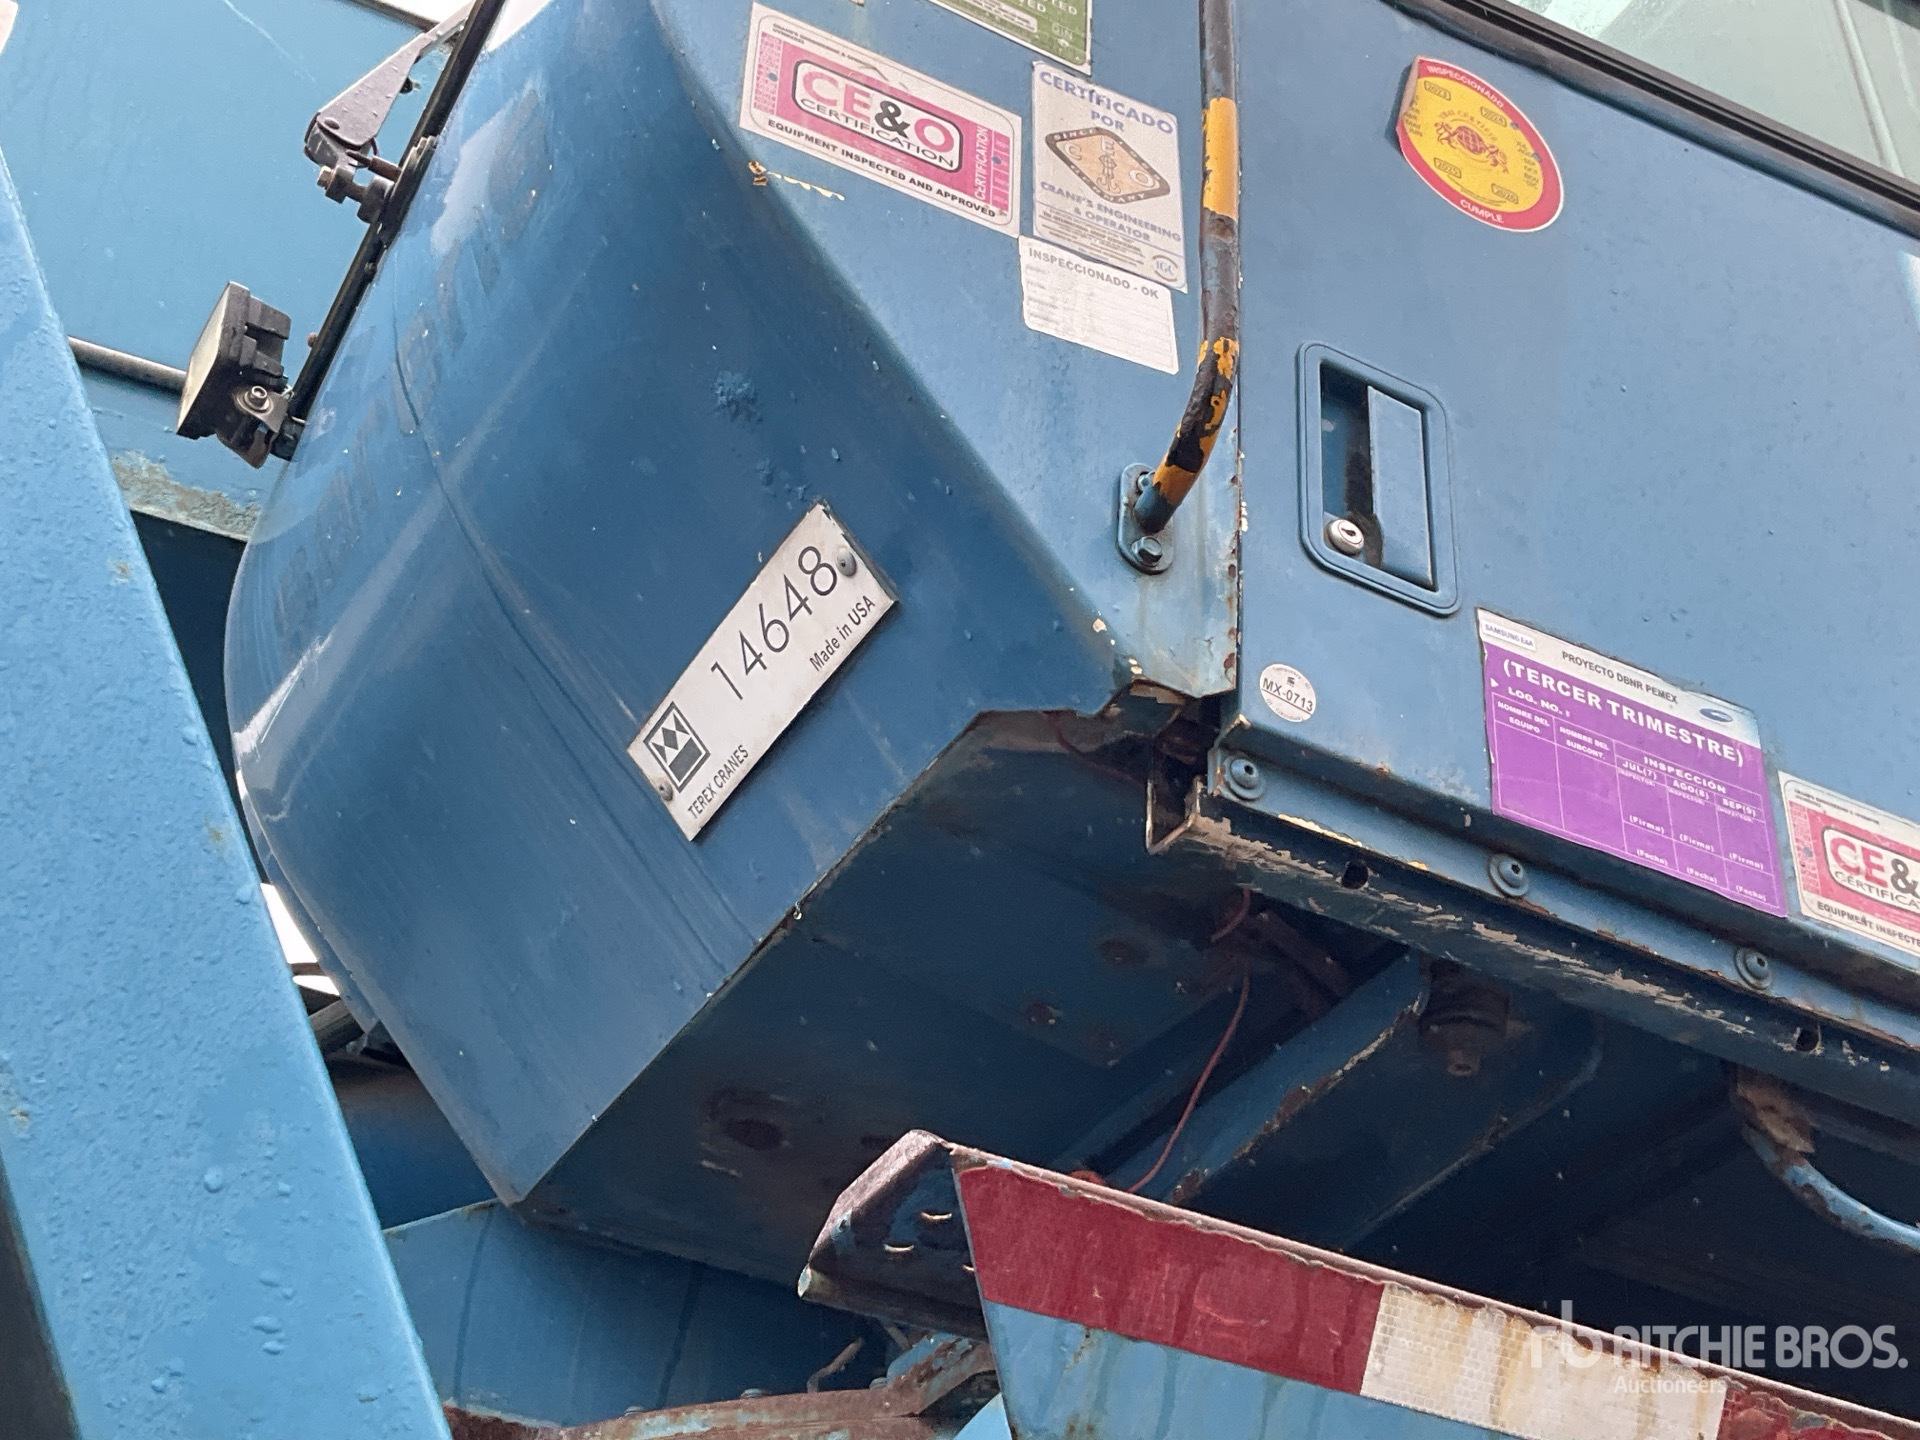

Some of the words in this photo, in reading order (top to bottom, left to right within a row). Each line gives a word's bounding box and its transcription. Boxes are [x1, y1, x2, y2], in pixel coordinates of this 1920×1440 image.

[1426, 65, 1504, 108] INSPECCIONADO
[802, 71, 954, 153] CE&O
[1040, 72, 1174, 134] CERTIFICADO
[800, 98, 954, 168] CERTIFICATION
[1091, 110, 1125, 132] POR
[768, 119, 838, 153] EQUIPMENT
[841, 149, 906, 181] INSPECTED
[909, 177, 933, 192] AND
[936, 188, 996, 218] APPROVED
[974, 125, 989, 200] CERTIFICATION
[1040, 181, 1094, 208] CRANE'S
[1097, 203, 1182, 242] ENGINEERING
[1460, 199, 1504, 223] CUMPLE
[1085, 211, 1151, 242] OPERATOR
[1029, 248, 1131, 289] INSPECCIONADO
[1140, 286, 1160, 300] OK
[710, 546, 838, 700] 14648
[809, 641, 841, 672] Made
[838, 622, 853, 641] in
[847, 595, 876, 627] USA
[1484, 624, 1520, 642] SAMSUNG
[1562, 650, 1615, 679] PROYECTO
[1616, 673, 1644, 691] DBNR
[1645, 683, 1678, 704] PEMEX
[1262, 677, 1313, 712] MX-0713
[1497, 701, 1533, 720] NOMBRE
[1534, 715, 1551, 727] DEL
[1503, 659, 1602, 711] (TERCER
[1607, 700, 1744, 768] TRIMESTRE)
[1508, 716, 1541, 733] EQUIPO
[1559, 726, 1593, 745] NOMBRE
[1594, 740, 1610, 751] DEL
[1566, 740, 1606, 759] SUBCONT.
[687, 782, 718, 819] TEREX
[713, 744, 750, 789] CRANES
[1622, 761, 1657, 781] JUL(7)
[1643, 756, 1727, 794] INSPECCIÓN
[1672, 780, 1710, 801] AGO(8)
[1722, 798, 1756, 818] SEP(9)
[1629, 814, 1665, 835] (Firma)
[1679, 833, 1714, 852] (Firma)
[1637, 849, 1668, 867] (Fecha)
[1729, 852, 1764, 871] (Firma)
[1686, 866, 1718, 885] (Fecha)
[1817, 902, 1874, 929] EQUIPMENT
